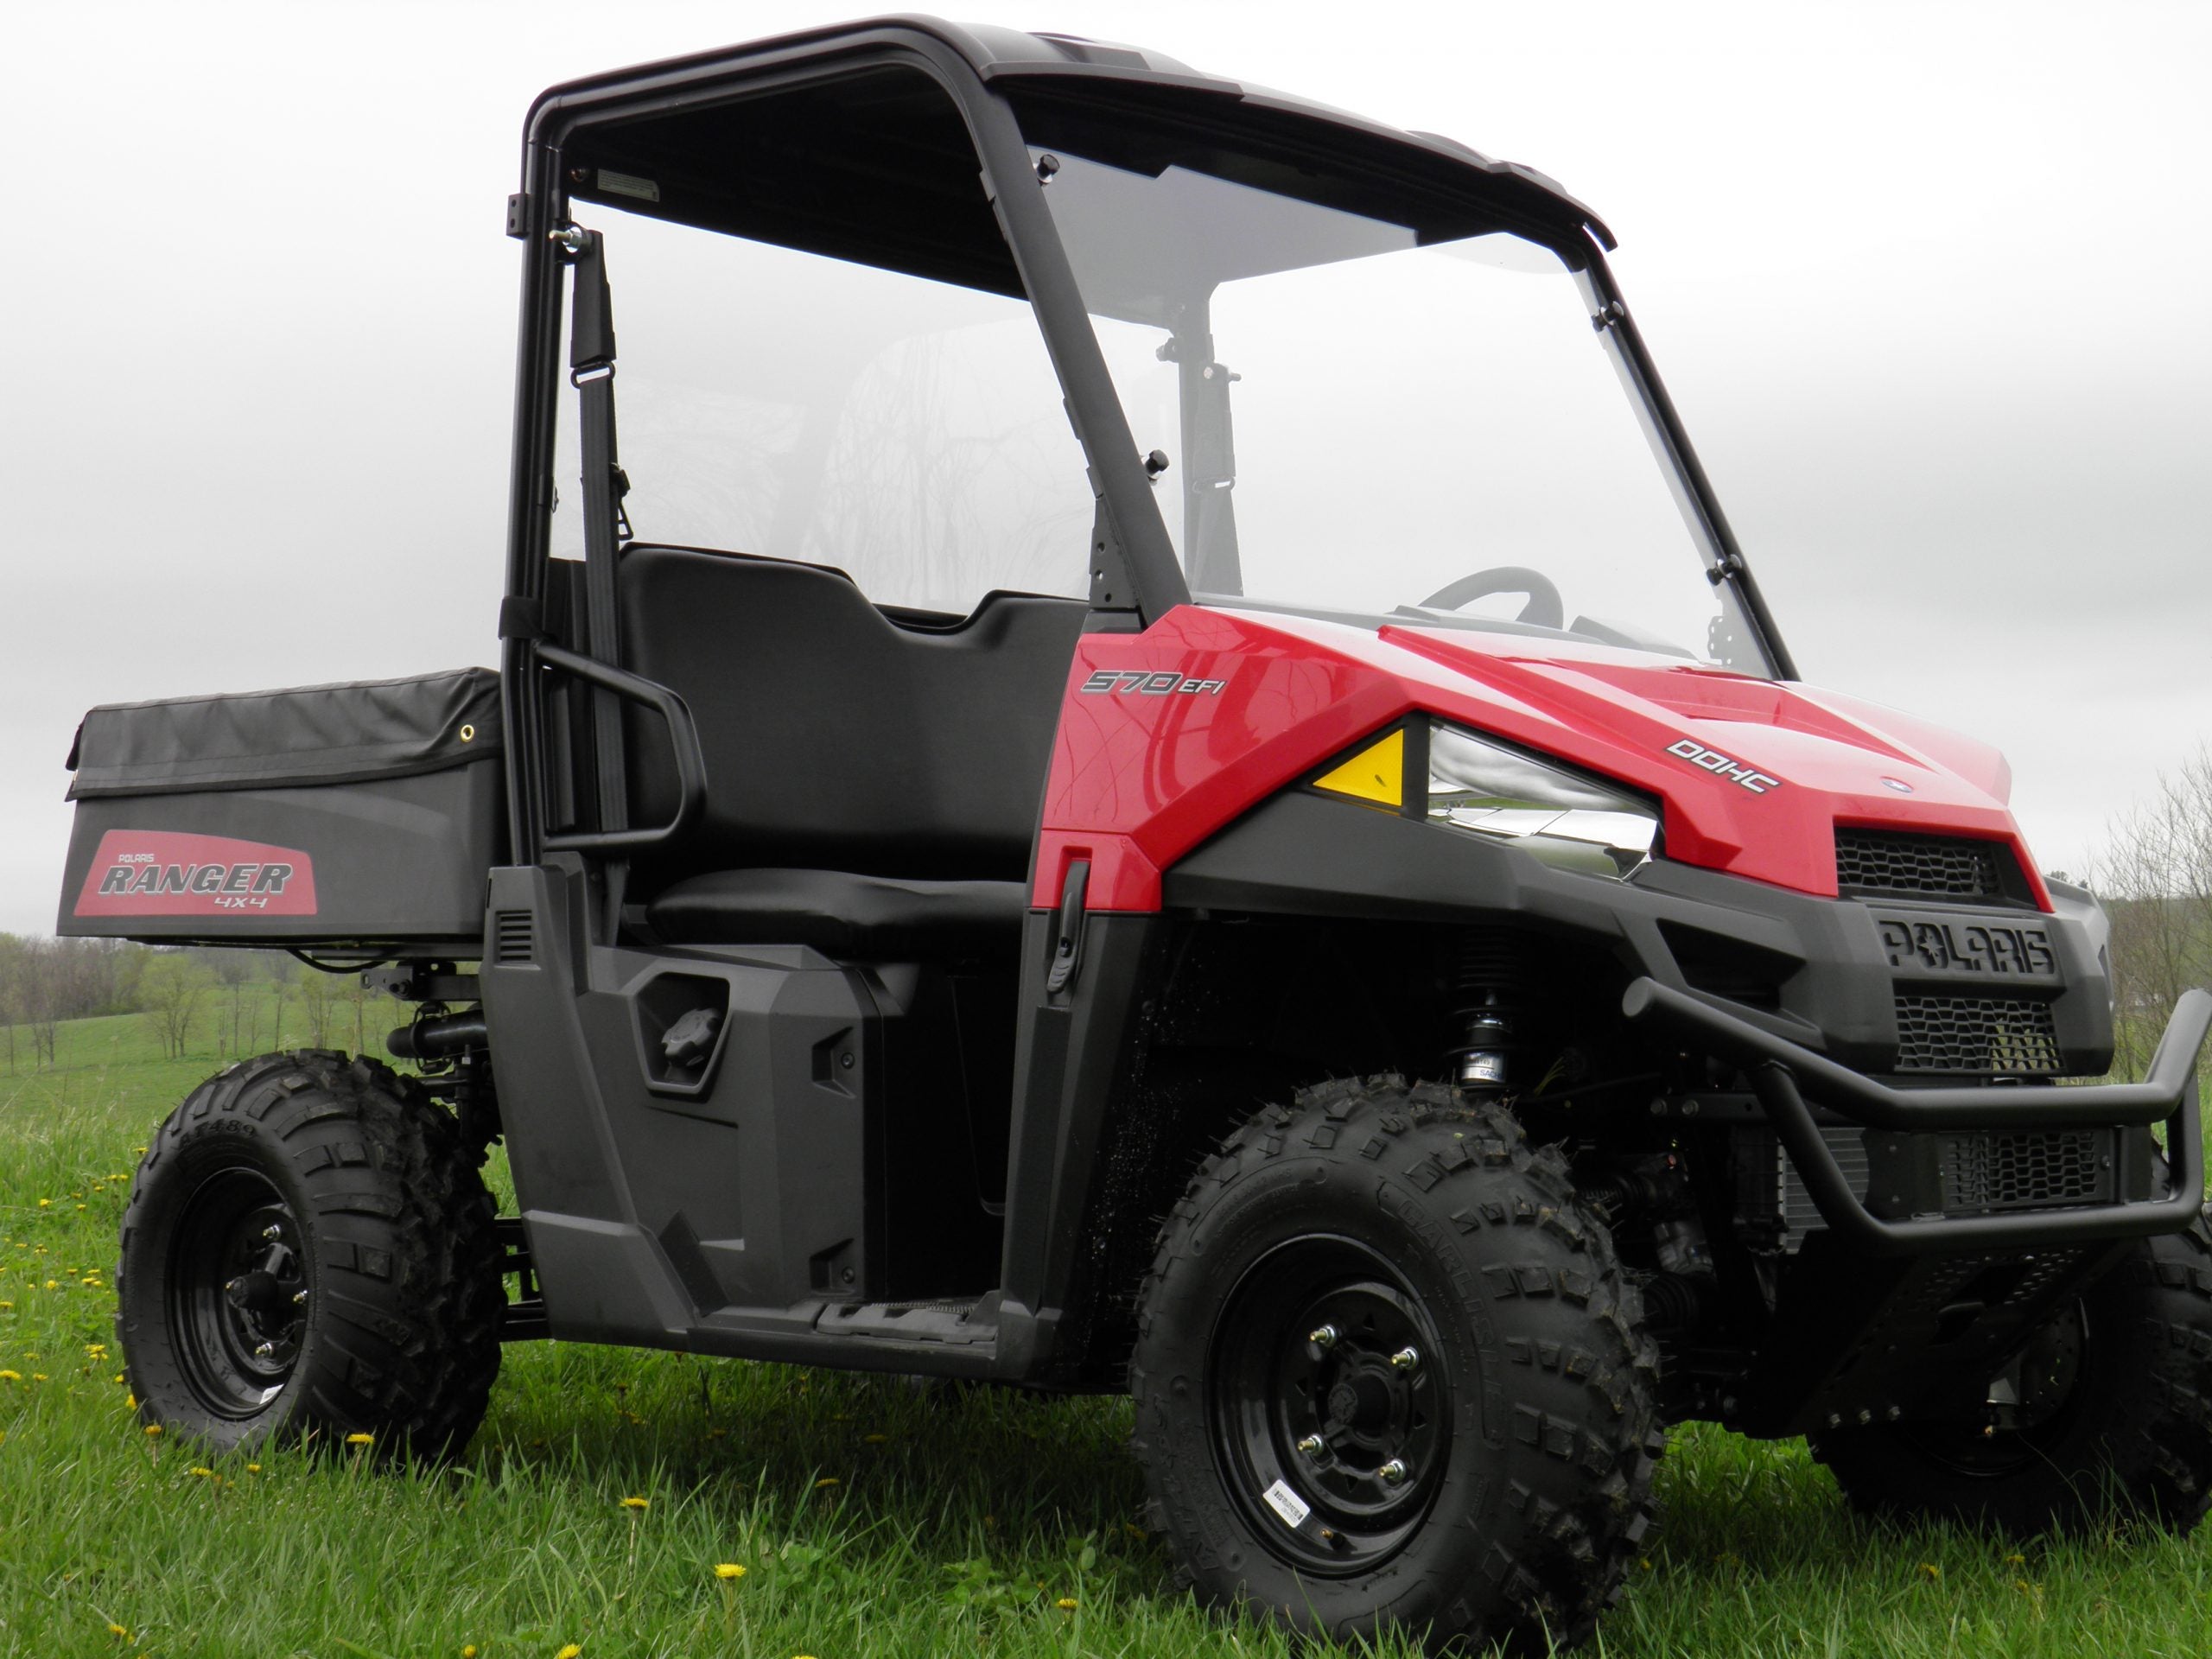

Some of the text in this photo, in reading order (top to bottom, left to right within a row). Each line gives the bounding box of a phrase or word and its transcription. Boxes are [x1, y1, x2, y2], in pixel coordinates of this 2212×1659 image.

[1081, 670, 1227, 695] 570 EFI
[1666, 739, 1781, 793] DOHC
[118, 854, 155, 863] POLARIS
[98, 864, 294, 895] RANGER
[1878, 920, 2055, 974] POLARIS
